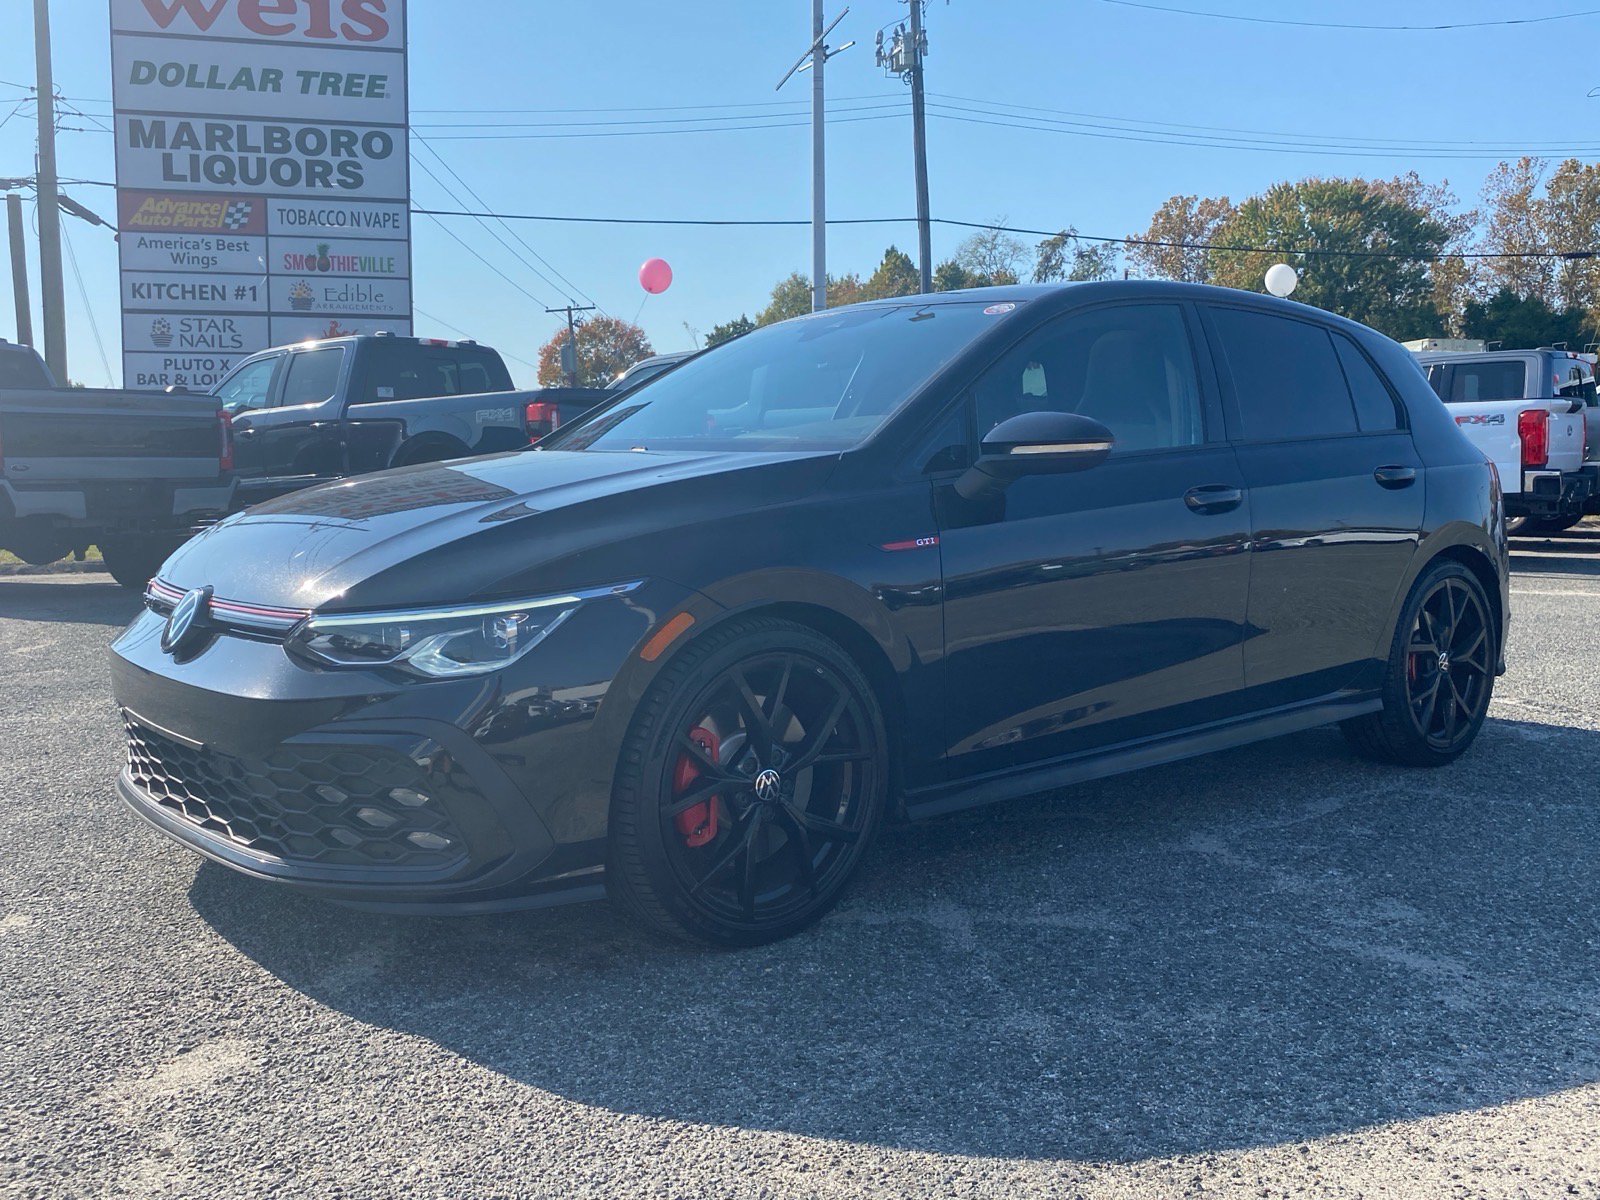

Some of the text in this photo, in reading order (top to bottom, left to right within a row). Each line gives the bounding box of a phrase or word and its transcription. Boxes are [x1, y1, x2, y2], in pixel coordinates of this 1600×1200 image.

[129, 60, 388, 99] DOLLAR TREE
[128, 118, 394, 161] MARLBORO
[162, 152, 364, 190] LIQUORS
[139, 197, 220, 216] Advance
[128, 212, 217, 228] Auto Parts
[277, 208, 400, 229] TOBACCO N VAPE
[137, 236, 250, 252] America's Best
[170, 252, 218, 269] Wings
[131, 282, 258, 302] KITCHEN #1
[324, 283, 385, 303] Edible
[315, 303, 395, 312] ARRANGEMENTS
[179, 318, 235, 333] STAR
[179, 333, 244, 349] NAILS
[163, 358, 231, 371] PLUTO X
[136, 373, 169, 386] BAR
[174, 373, 188, 386] &
[1454, 413, 1505, 427] FX4
[916, 537, 935, 546] GTI
